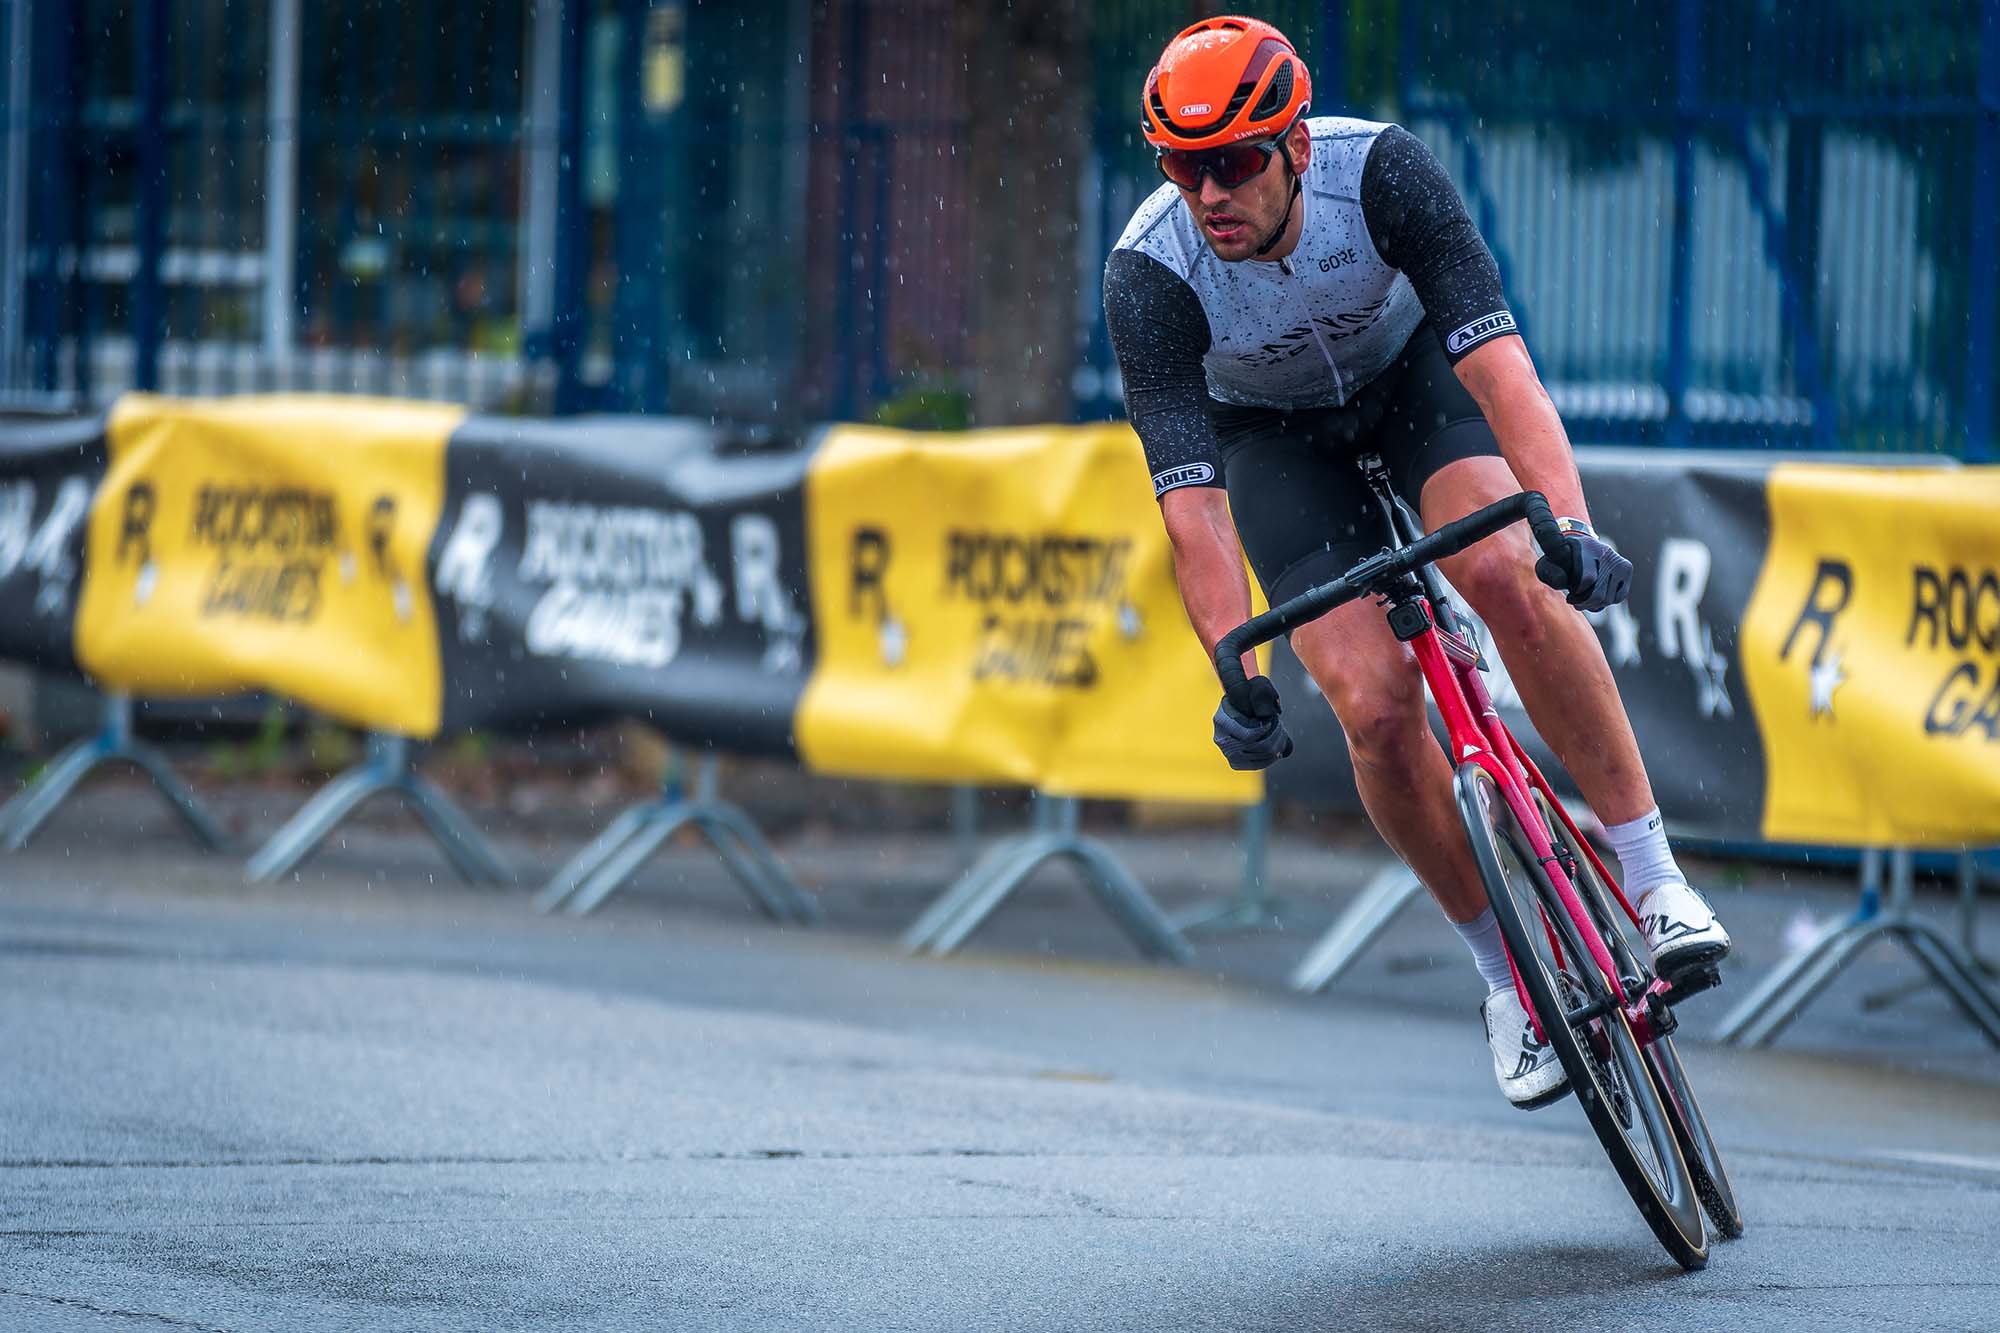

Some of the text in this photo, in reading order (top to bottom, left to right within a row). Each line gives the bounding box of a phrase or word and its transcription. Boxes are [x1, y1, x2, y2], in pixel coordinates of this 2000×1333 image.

[1318, 247, 1359, 273] GORE
[1456, 314, 1512, 348] ABUS
[1154, 467, 1204, 492] ABUS
